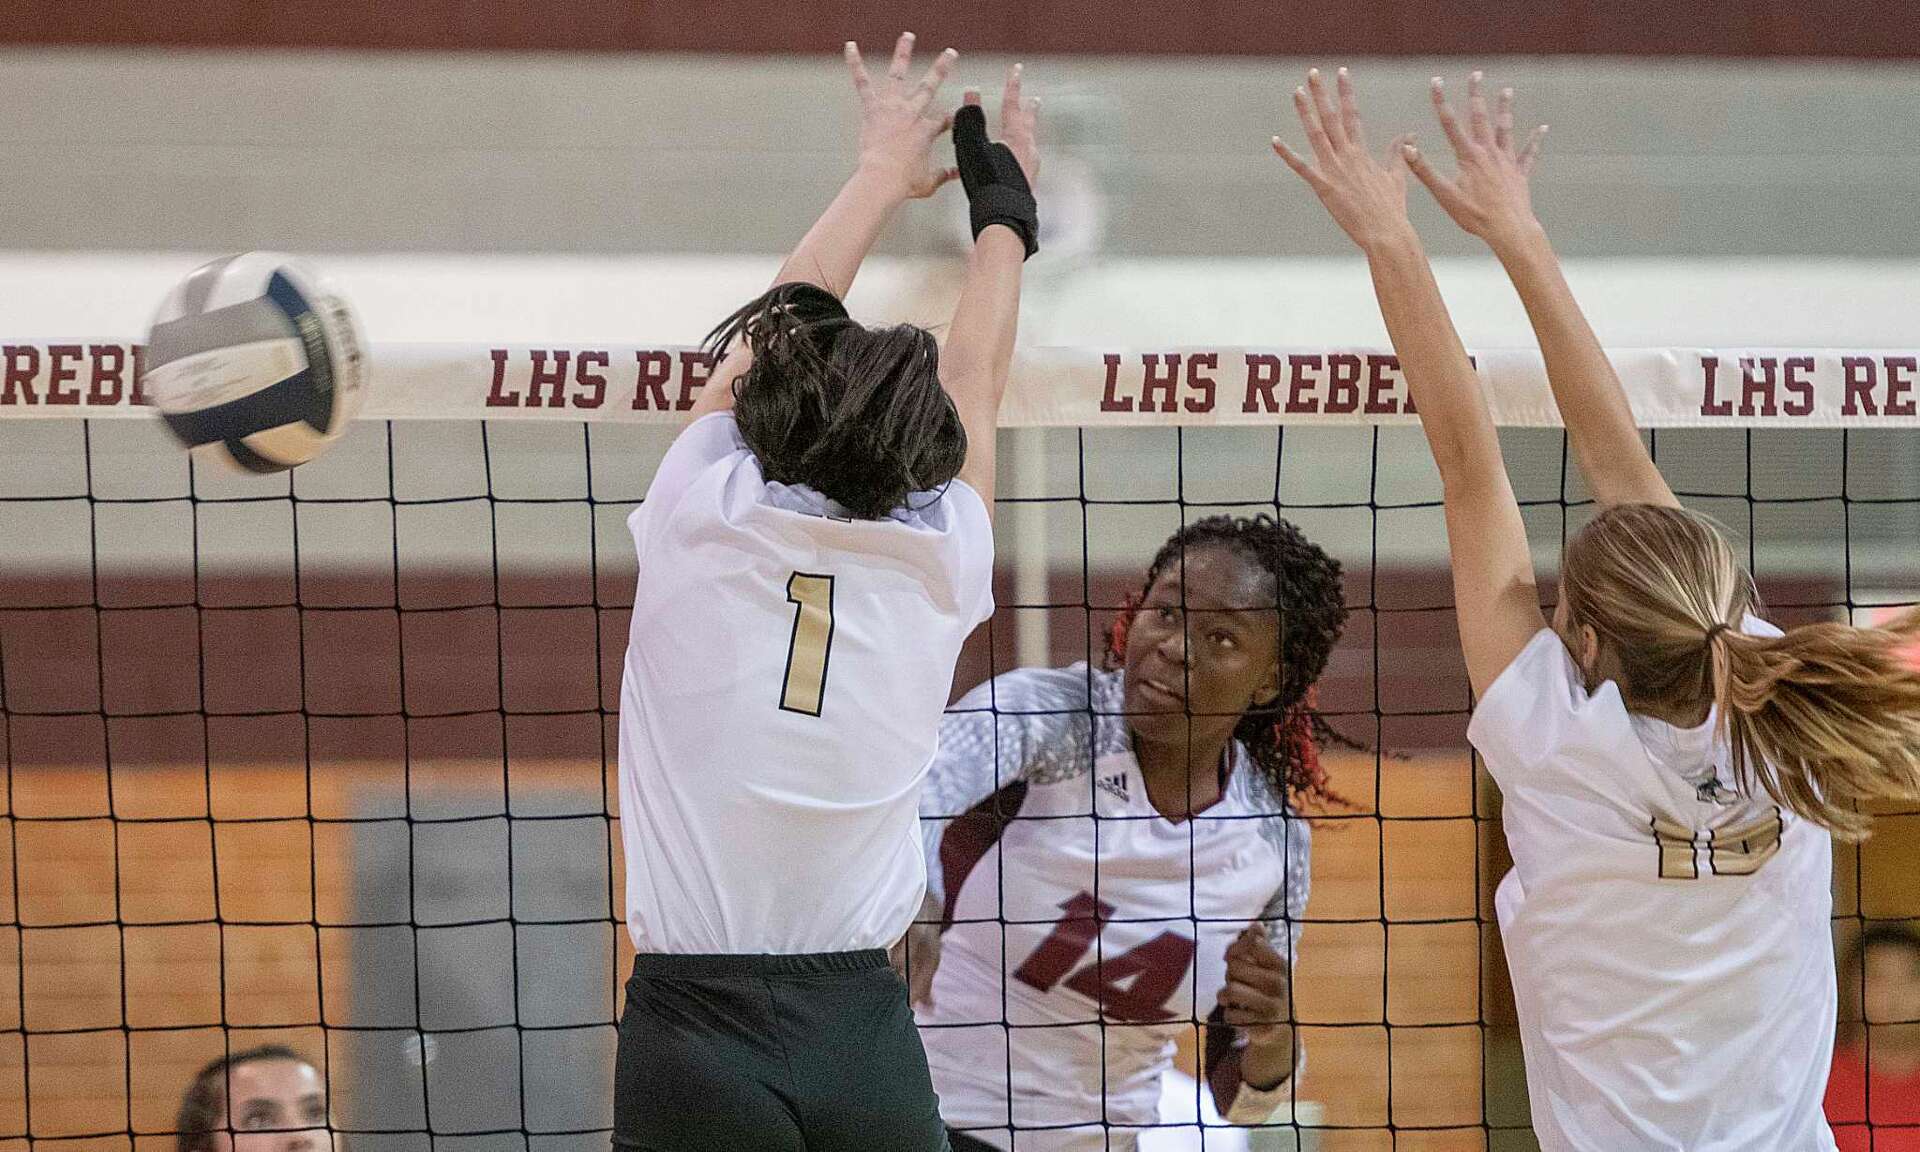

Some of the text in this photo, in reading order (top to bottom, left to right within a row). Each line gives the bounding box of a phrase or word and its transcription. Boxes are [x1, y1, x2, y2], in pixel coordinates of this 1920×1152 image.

[486, 350, 609, 408] LHS
[1100, 353, 1476, 414] LHS REBE
[1701, 357, 1815, 416] LHS
[779, 571, 834, 717] 1
[1013, 890, 1198, 1021] 14
